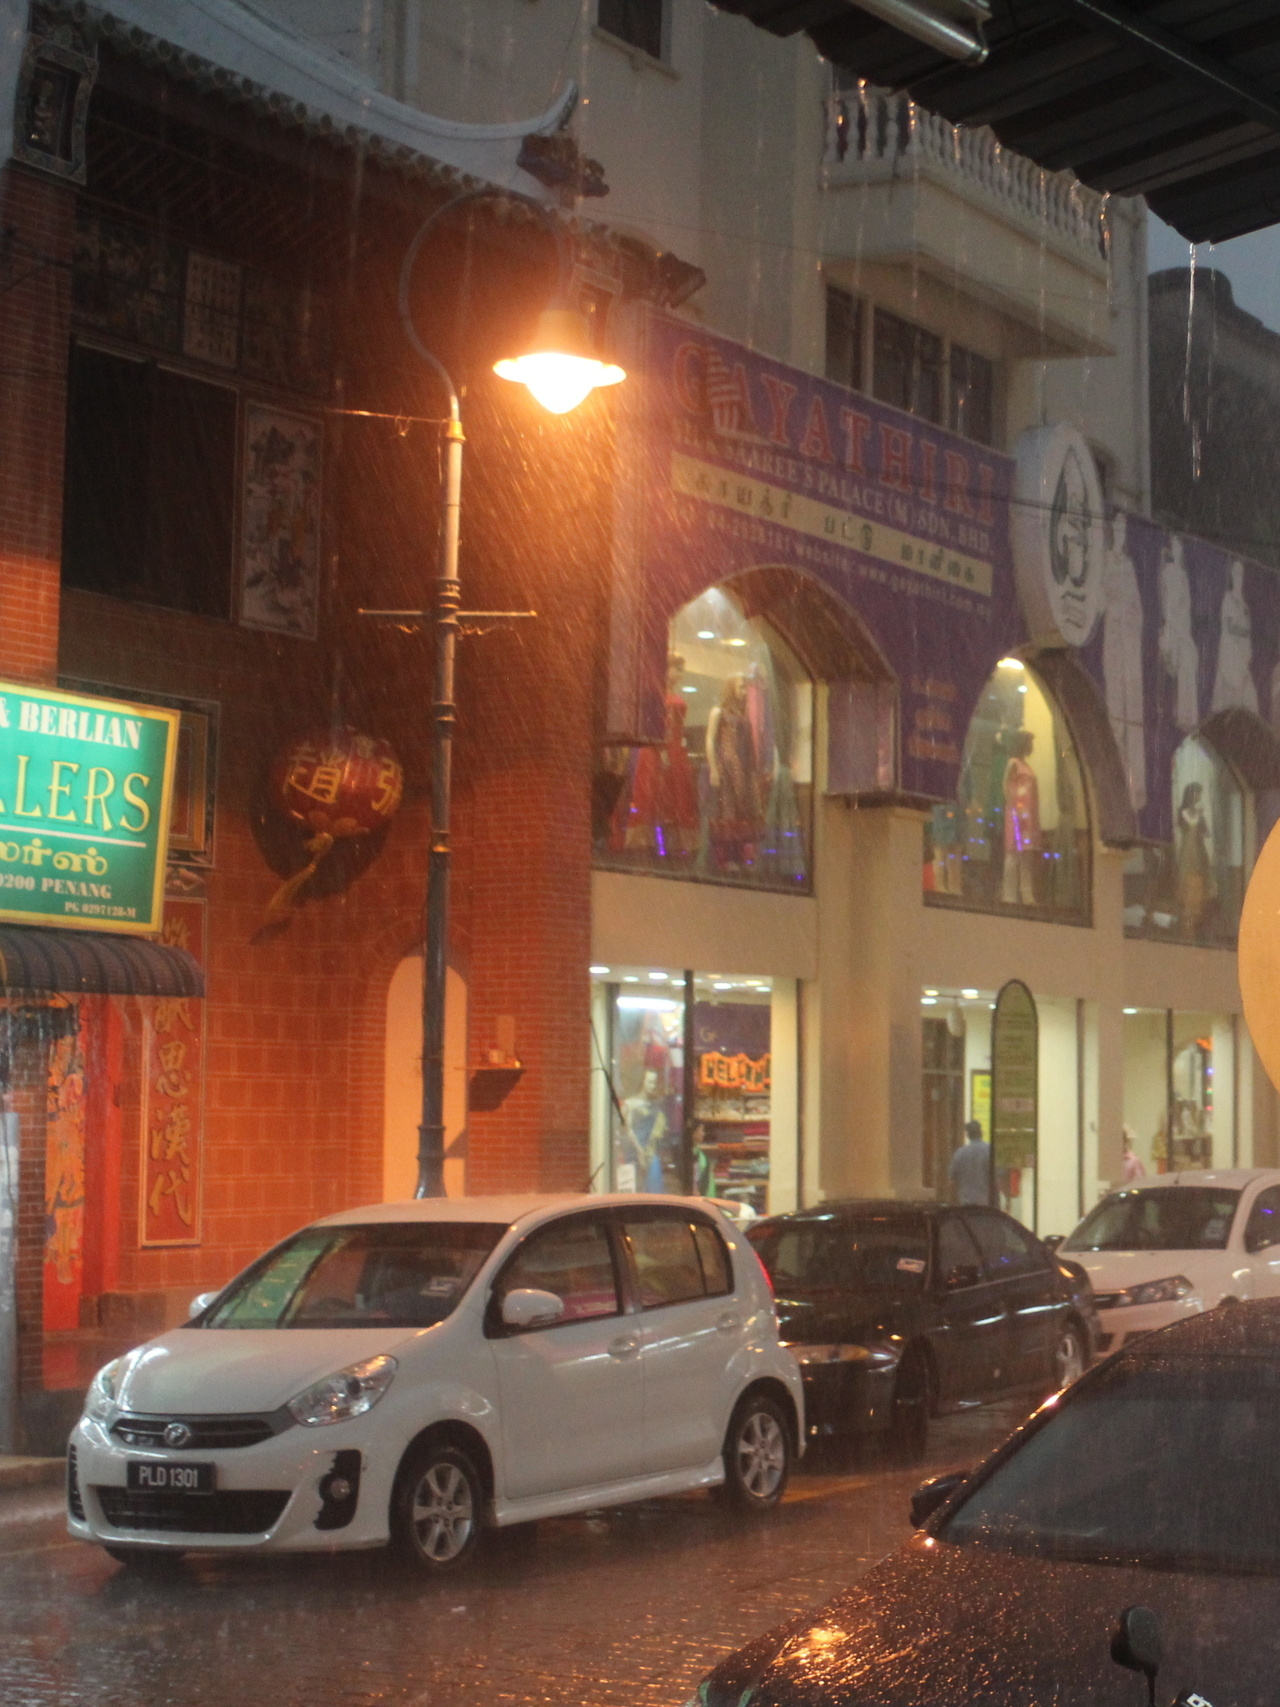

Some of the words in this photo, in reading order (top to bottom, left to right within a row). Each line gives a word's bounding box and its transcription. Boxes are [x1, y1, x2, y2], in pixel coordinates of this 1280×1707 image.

[818, 469, 885, 515] PALACE
[18, 701, 143, 749] BERLIAN
[0, 755, 151, 832] LERS
[41, 878, 112, 899] PENANG
[138, 1465, 167, 1487] PLD
[170, 1467, 198, 1488] 1301
